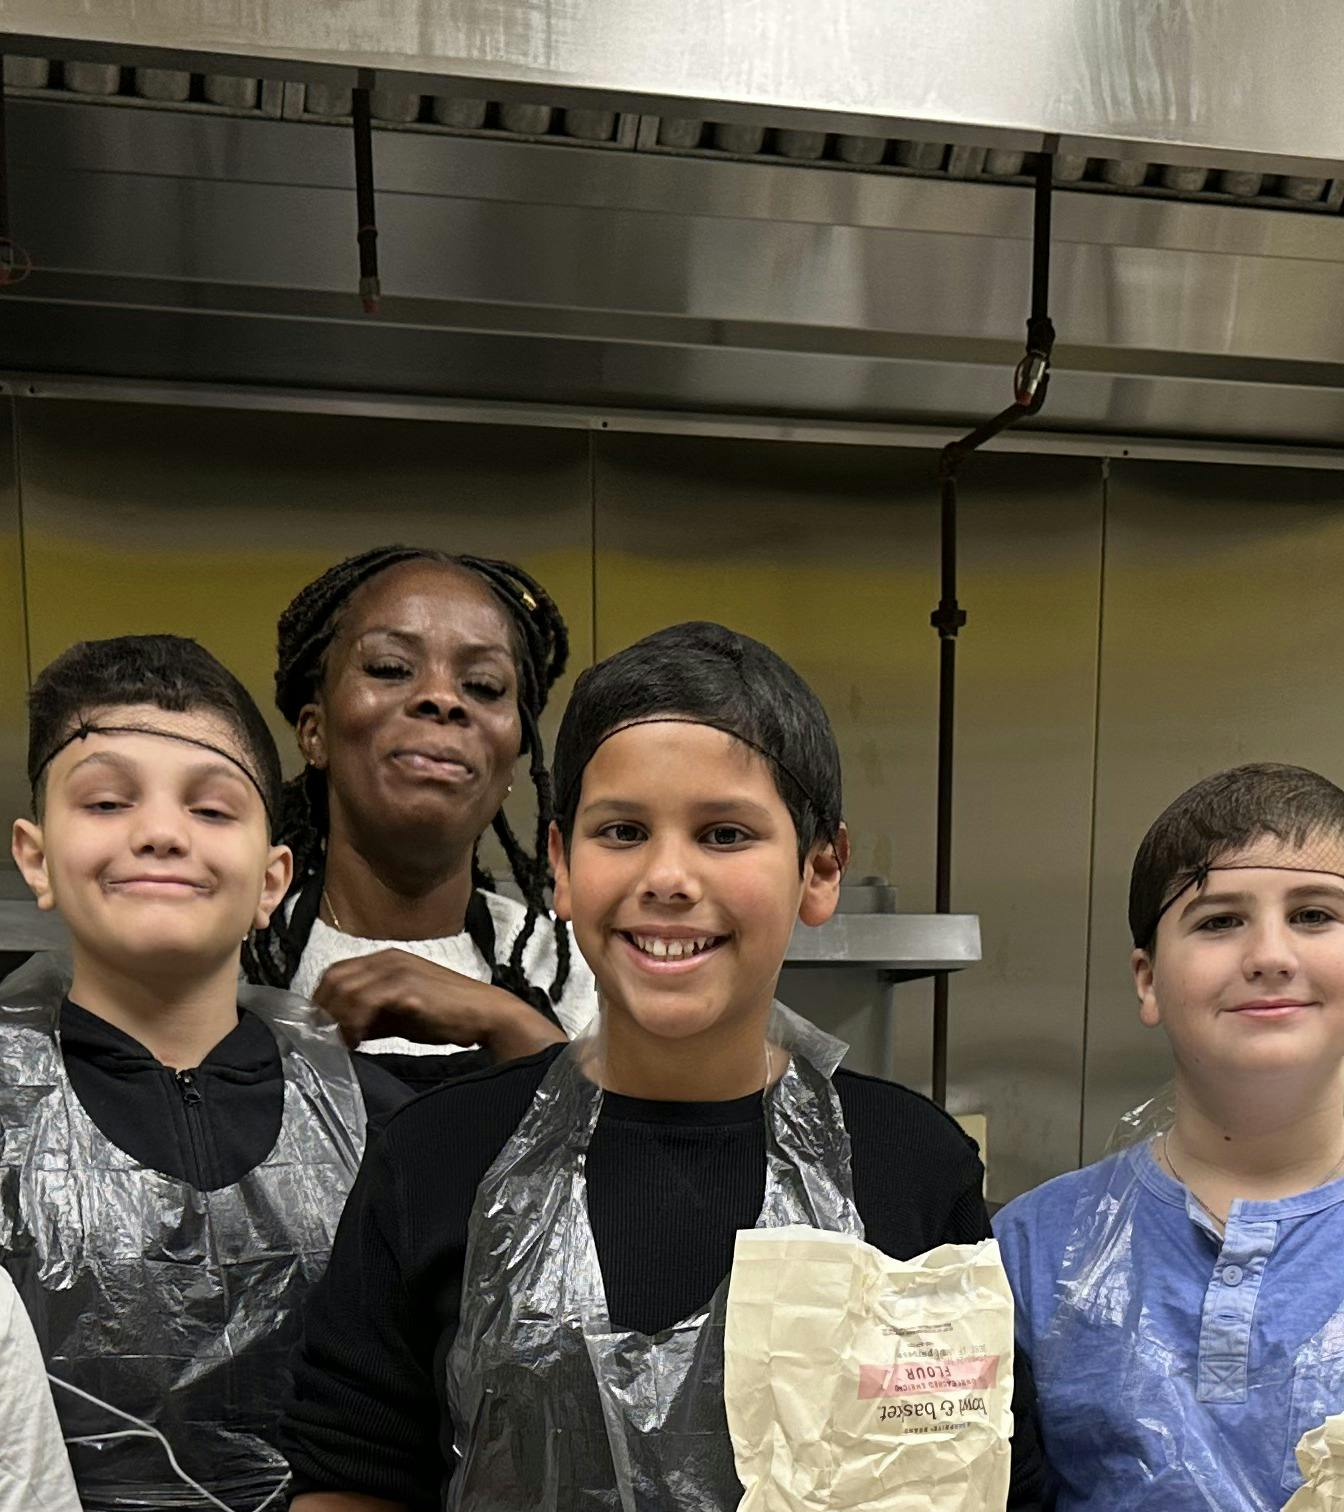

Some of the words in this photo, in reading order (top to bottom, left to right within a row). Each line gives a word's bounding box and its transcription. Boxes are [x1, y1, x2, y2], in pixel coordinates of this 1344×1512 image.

[905, 1365, 951, 1380] FLOUR
[940, 1400, 955, 1416] &
[958, 1397, 988, 1416] bowl
